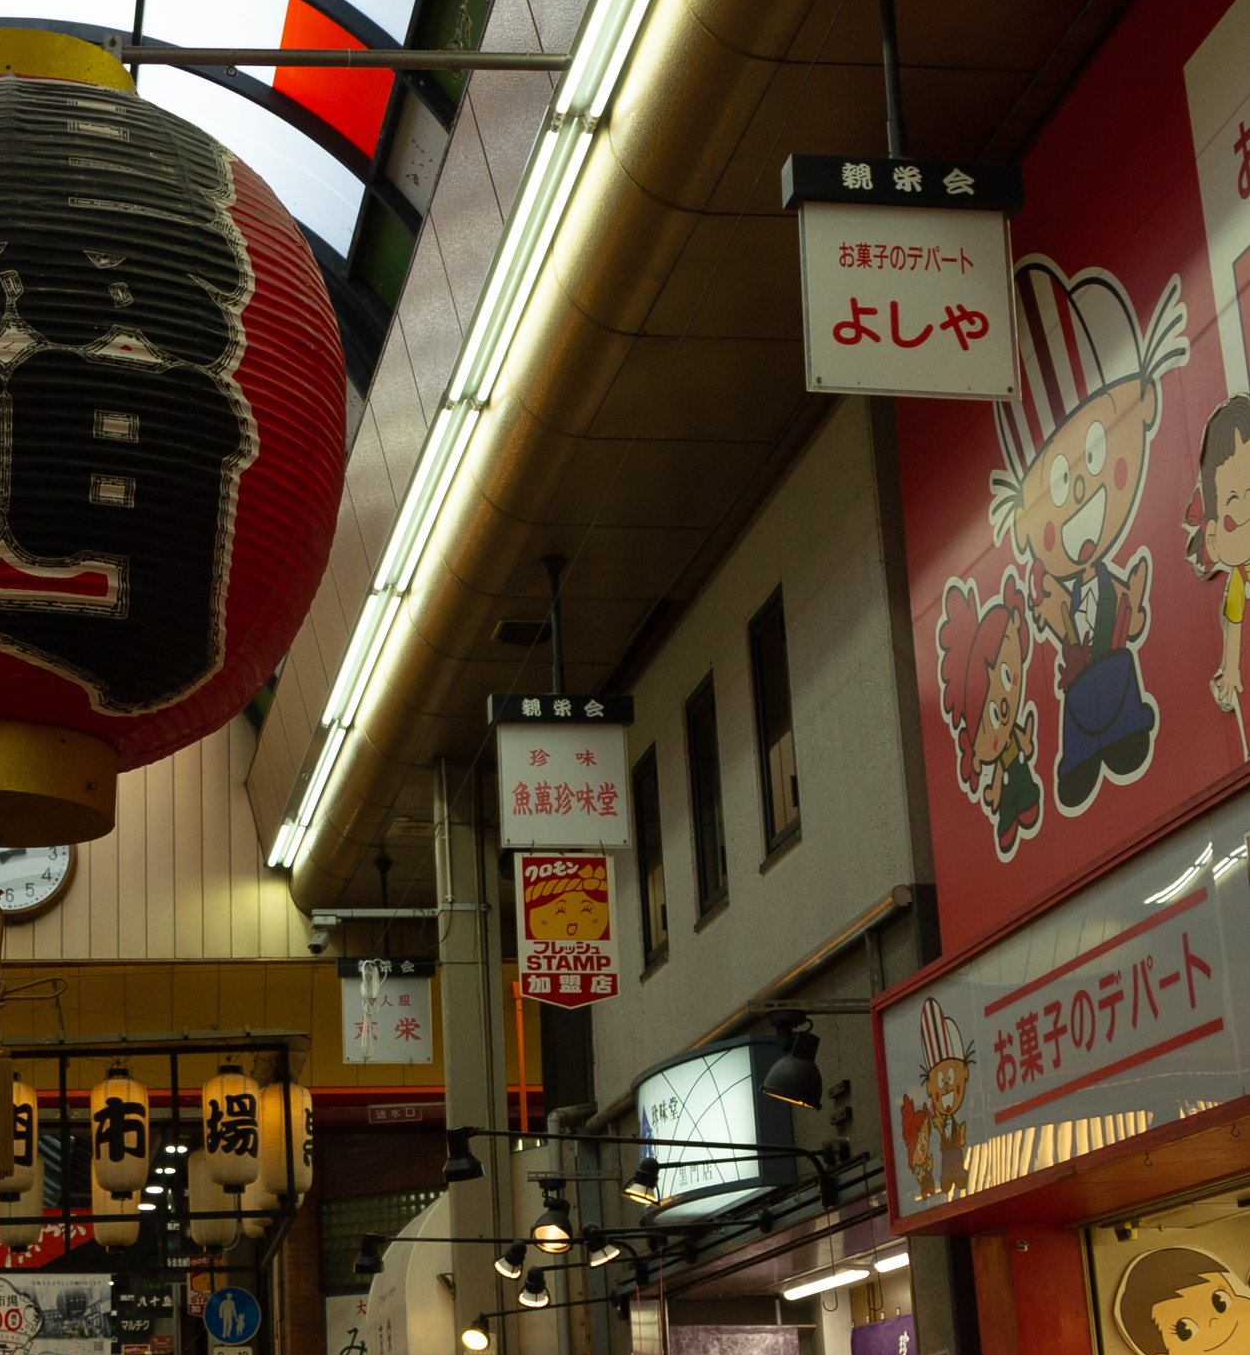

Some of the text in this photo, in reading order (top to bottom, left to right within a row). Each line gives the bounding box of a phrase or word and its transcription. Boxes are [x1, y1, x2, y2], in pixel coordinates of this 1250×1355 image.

[842, 162, 975, 196] 親栄会
[839, 242, 973, 275] お菓子のデパート
[833, 298, 989, 351] よしや
[522, 698, 604, 717] 親栄会
[529, 749, 596, 766] 珍味
[512, 781, 618, 818] 魚萬珍味堂
[41, 867, 54, 882] 4
[525, 861, 578, 880] クロモン
[25, 883, 35, 898] 5
[533, 941, 601, 955] フレッシュ
[527, 955, 610, 971] STAMP
[527, 975, 613, 995] 加盟店
[368, 994, 411, 1007] 人服
[994, 932, 1211, 1093] お菓子のデパート
[651, 1097, 679, 1126] 珍味堂
